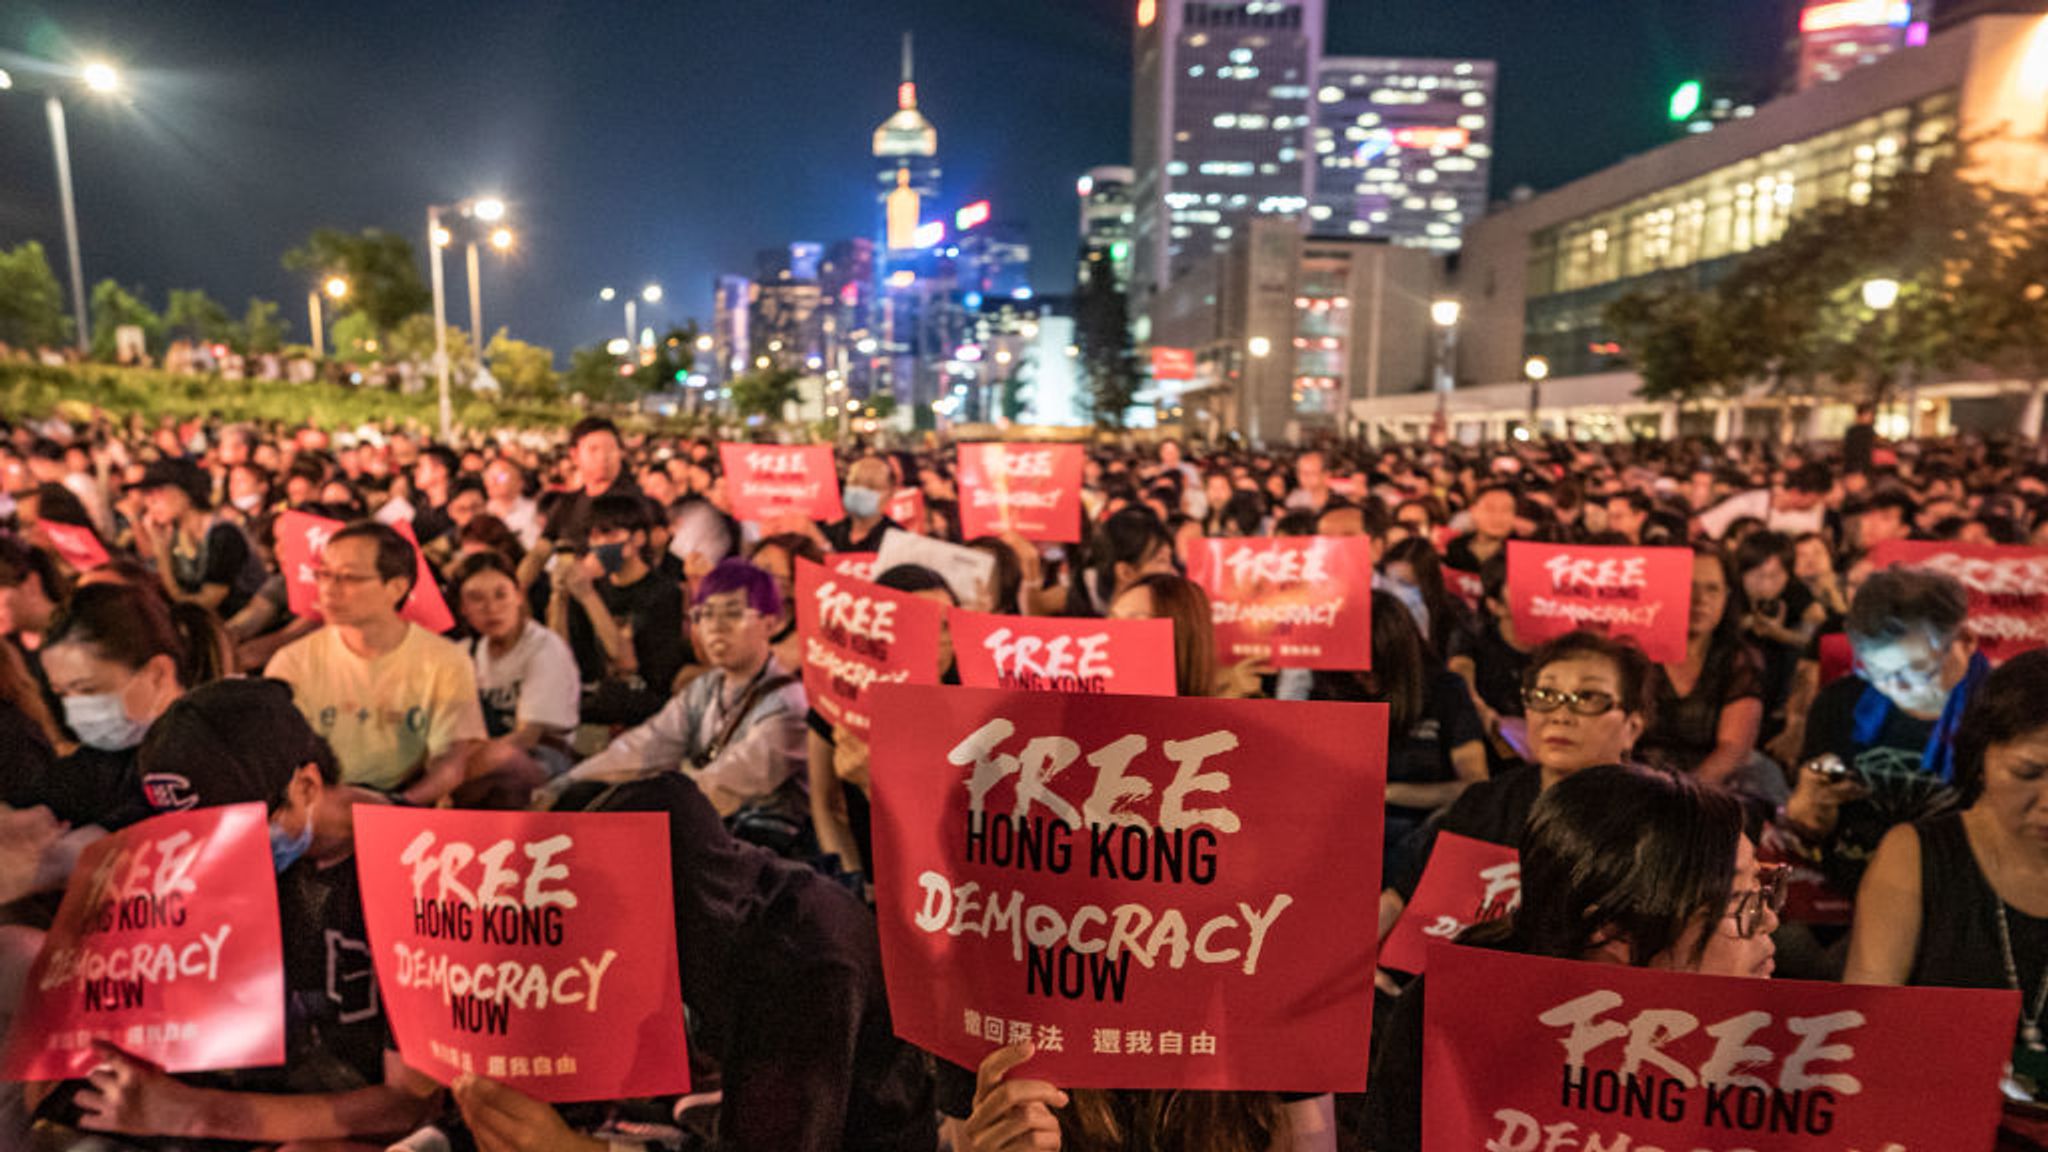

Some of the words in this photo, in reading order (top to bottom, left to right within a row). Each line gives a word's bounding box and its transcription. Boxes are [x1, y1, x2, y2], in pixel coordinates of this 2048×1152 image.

[1544, 554, 1647, 589] FREE
[815, 581, 898, 644] FREE
[983, 628, 1115, 679] FREE
[947, 717, 1242, 839] FREE
[401, 830, 578, 914] FREE
[966, 810, 1073, 876] HONG
[1089, 822, 1218, 885] KONG
[413, 897, 473, 943] HONG
[481, 903, 564, 947] KONG
[914, 870, 1294, 976] DEMOCRACY
[83, 974, 144, 1014] NOW
[394, 940, 618, 1013] DEMOCRACY
[1026, 940, 1131, 1004] NOW
[451, 993, 510, 1036] NOW
[1538, 989, 1867, 1097] FREE
[1560, 1063, 1687, 1124] HONG
[1703, 1081, 1838, 1137] KONG
